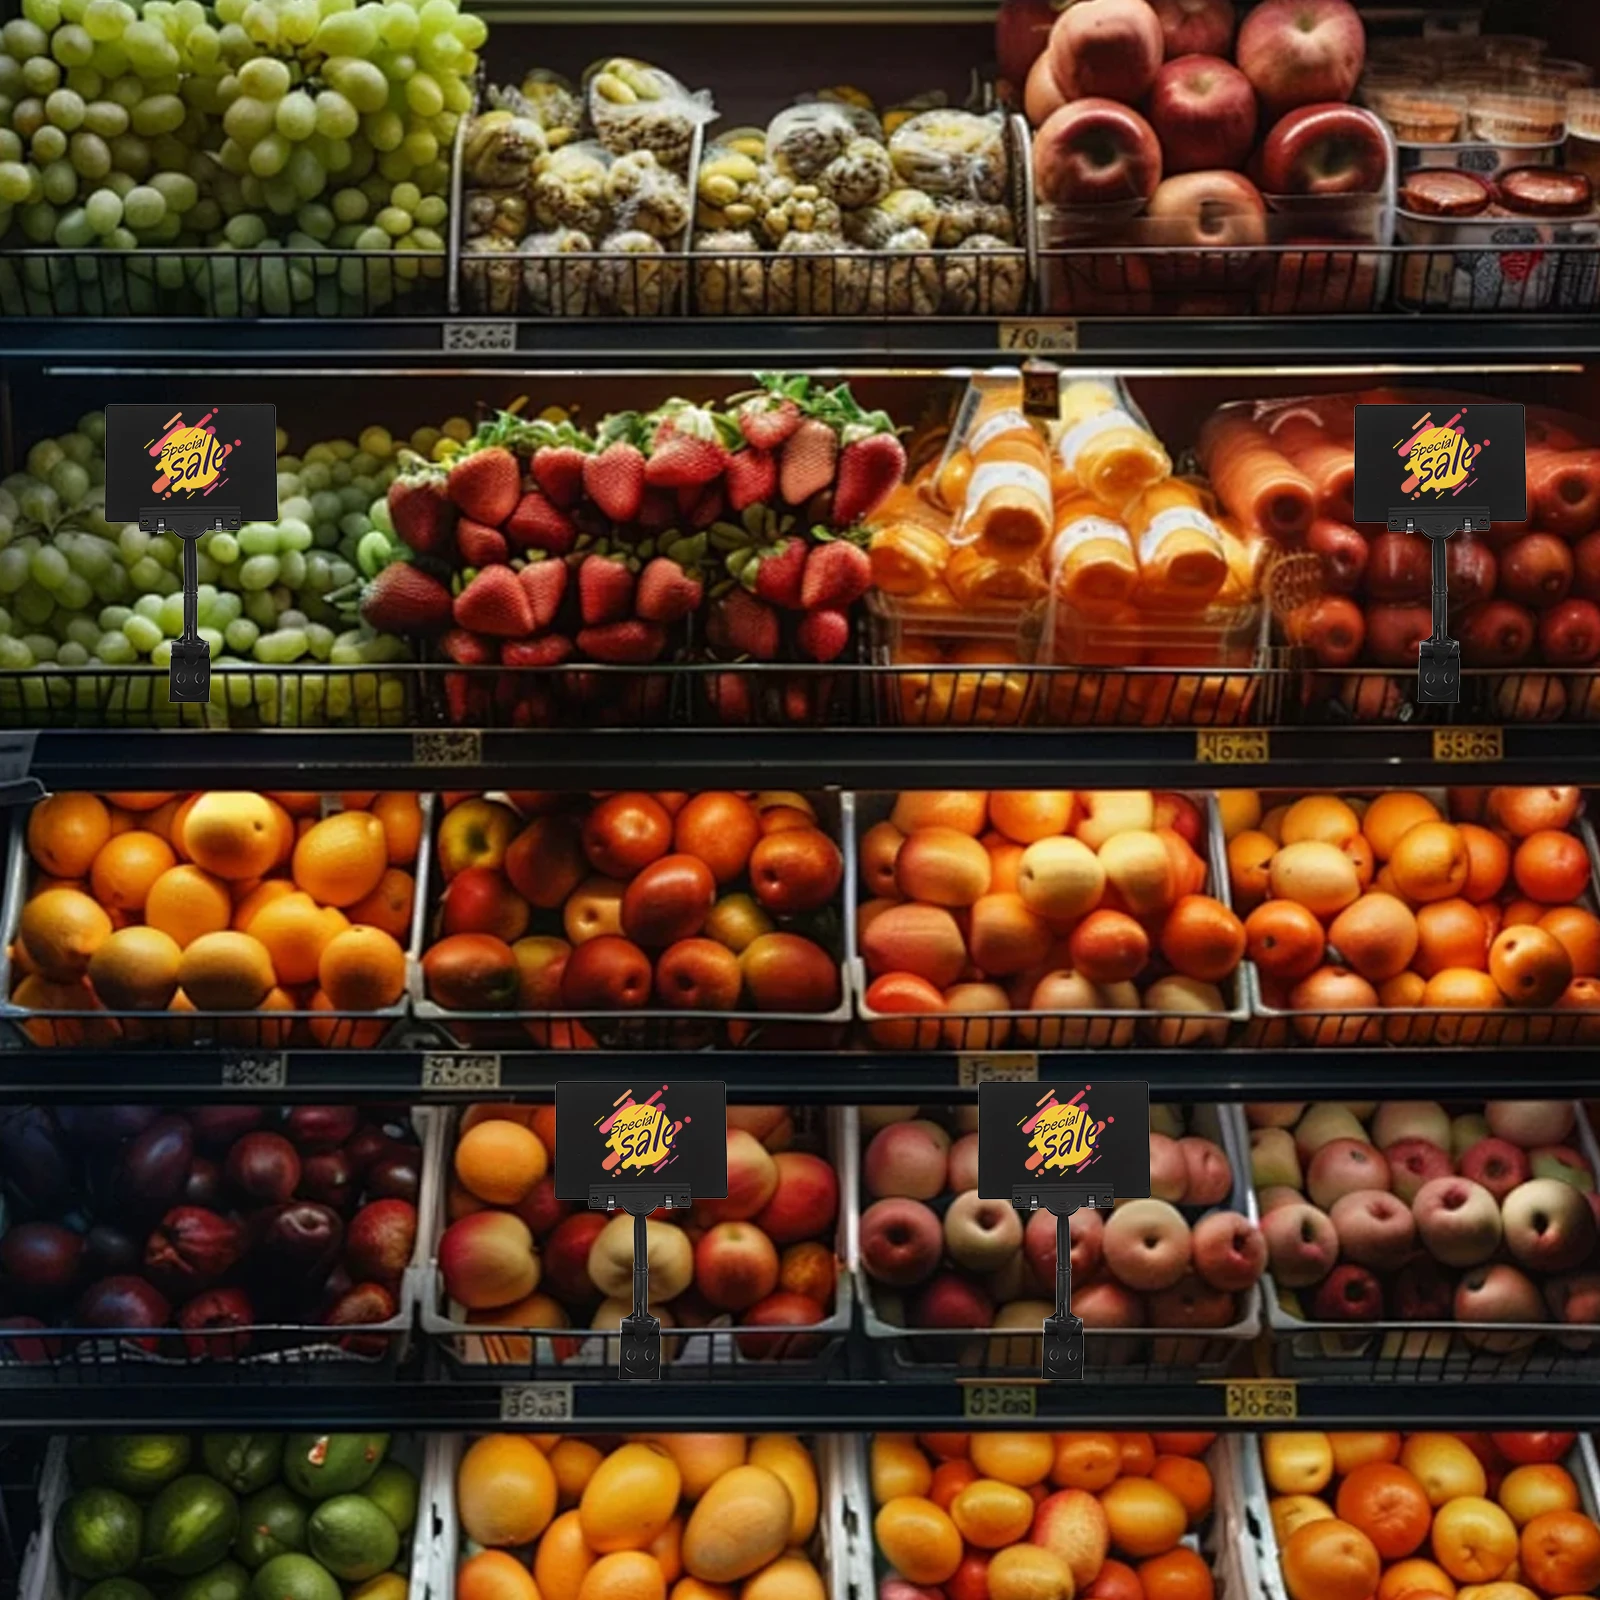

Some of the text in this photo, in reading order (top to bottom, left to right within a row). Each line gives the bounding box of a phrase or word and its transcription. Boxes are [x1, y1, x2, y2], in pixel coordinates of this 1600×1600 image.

[159, 433, 207, 461] Special
[170, 433, 226, 484] sale
[1408, 433, 1456, 461] Special
[1419, 433, 1475, 484] sale
[609, 1110, 657, 1138] Special
[620, 1110, 676, 1161] sale
[1032, 1110, 1080, 1138] Special
[1043, 1110, 1099, 1161] sale
